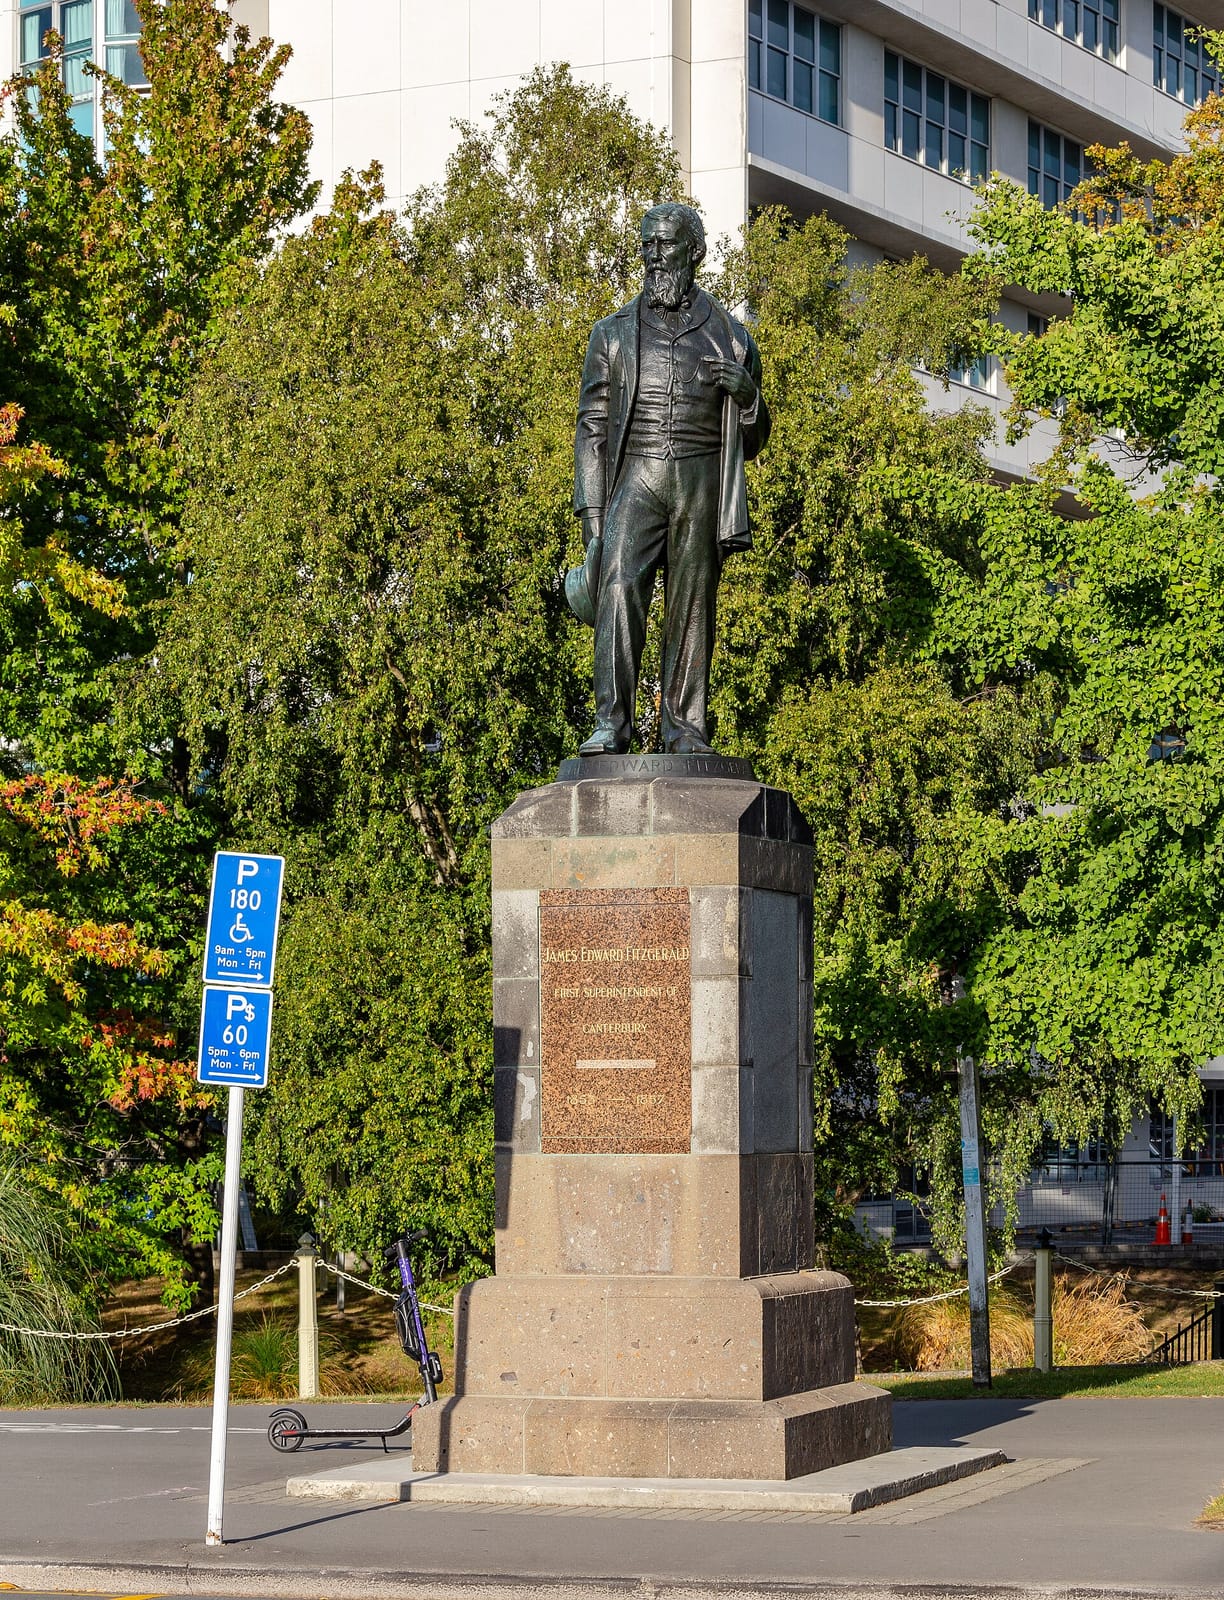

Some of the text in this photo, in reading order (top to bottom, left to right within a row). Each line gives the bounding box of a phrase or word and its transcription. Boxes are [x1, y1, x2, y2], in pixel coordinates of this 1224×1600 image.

[599, 759, 673, 774] EDWARD
[236, 859, 259, 886] P
[229, 888, 262, 911] 180
[214, 944, 235, 956] 9am
[245, 947, 266, 959] 5pm
[543, 946, 690, 963] JAMES EDWARD FITZGERALD
[217, 956, 238, 968] Mon
[248, 960, 262, 970] Fri
[554, 986, 679, 999] FIRST SUPERINTENDENT OF
[222, 1024, 248, 1046] 60
[582, 1023, 648, 1034] CANTERBURY
[207, 1046, 229, 1058] 5pm
[239, 1048, 260, 1060] 6pm
[210, 1058, 232, 1069] Mon
[242, 1061, 256, 1071] Fri
